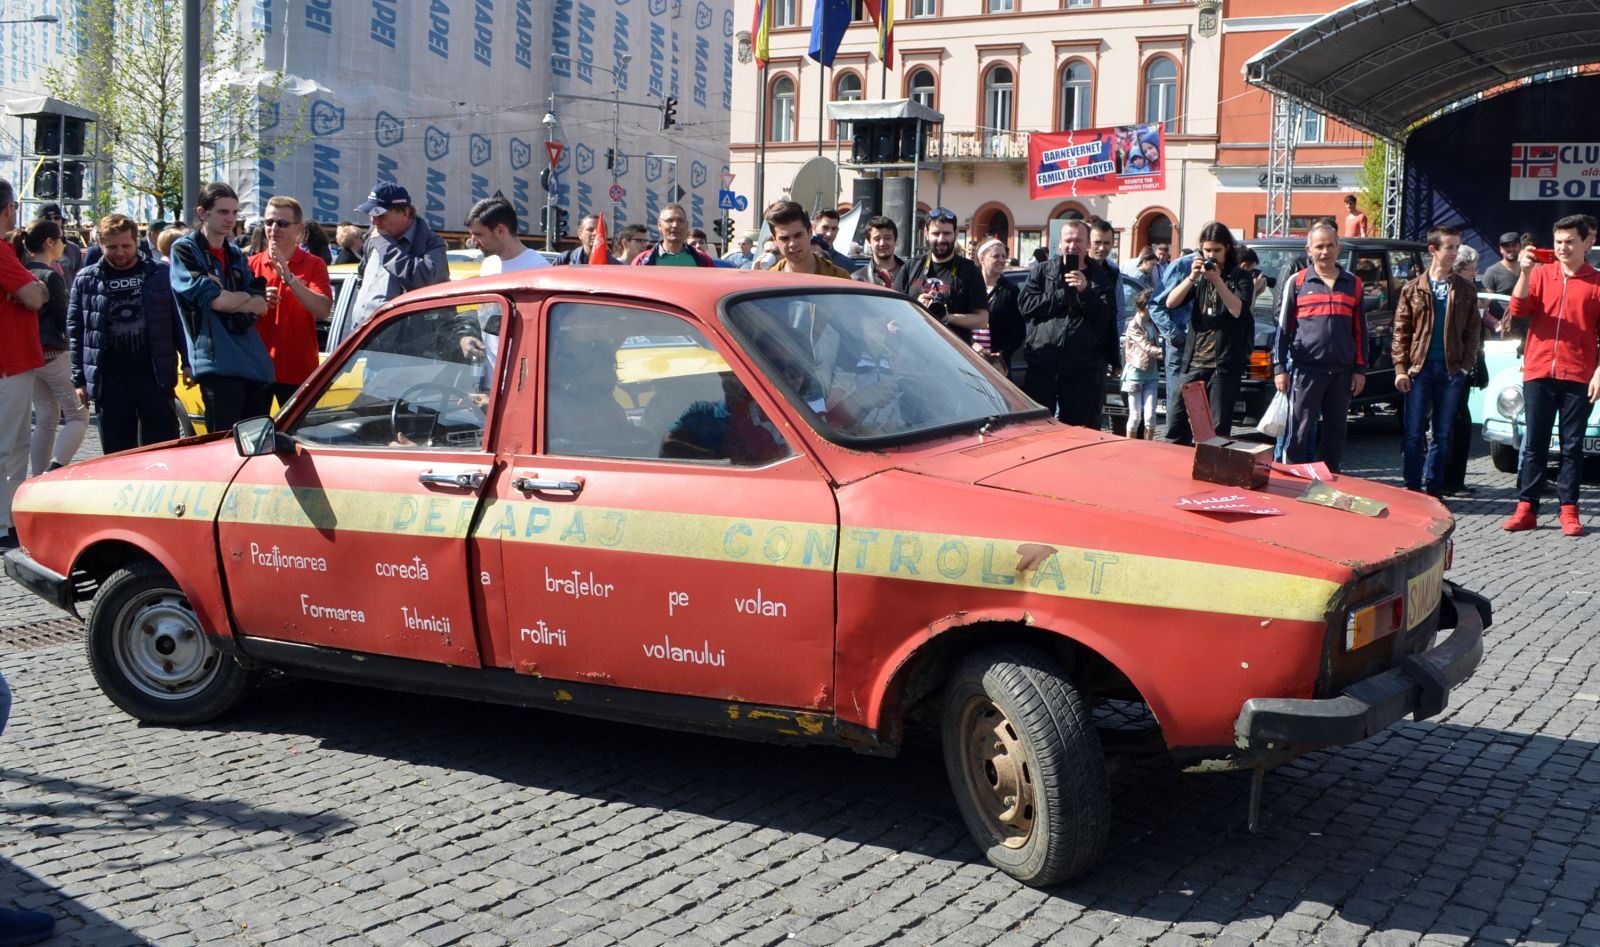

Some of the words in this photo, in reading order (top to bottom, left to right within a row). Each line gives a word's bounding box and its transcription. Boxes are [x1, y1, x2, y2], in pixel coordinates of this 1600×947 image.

[371, 0, 396, 49] PEI
[551, 0, 573, 78] MAPEI
[577, 2, 596, 85] MAPEI
[649, 21, 665, 98] MAPEI
[694, 34, 710, 108] MAPEI
[1037, 170, 1066, 184] FAMILY
[1067, 161, 1114, 179] DESTROYER
[1043, 142, 1101, 162] BARNEVERNET
[1314, 174, 1338, 185] Bank
[480, 571, 491, 585] a
[544, 566, 614, 599] brațelor
[668, 589, 689, 616] pe
[734, 588, 787, 617] volan
[723, 522, 1119, 595] CONTROLAT
[300, 593, 366, 624] Formarea
[520, 619, 567, 647] rotirii
[643, 634, 726, 667] volanului
